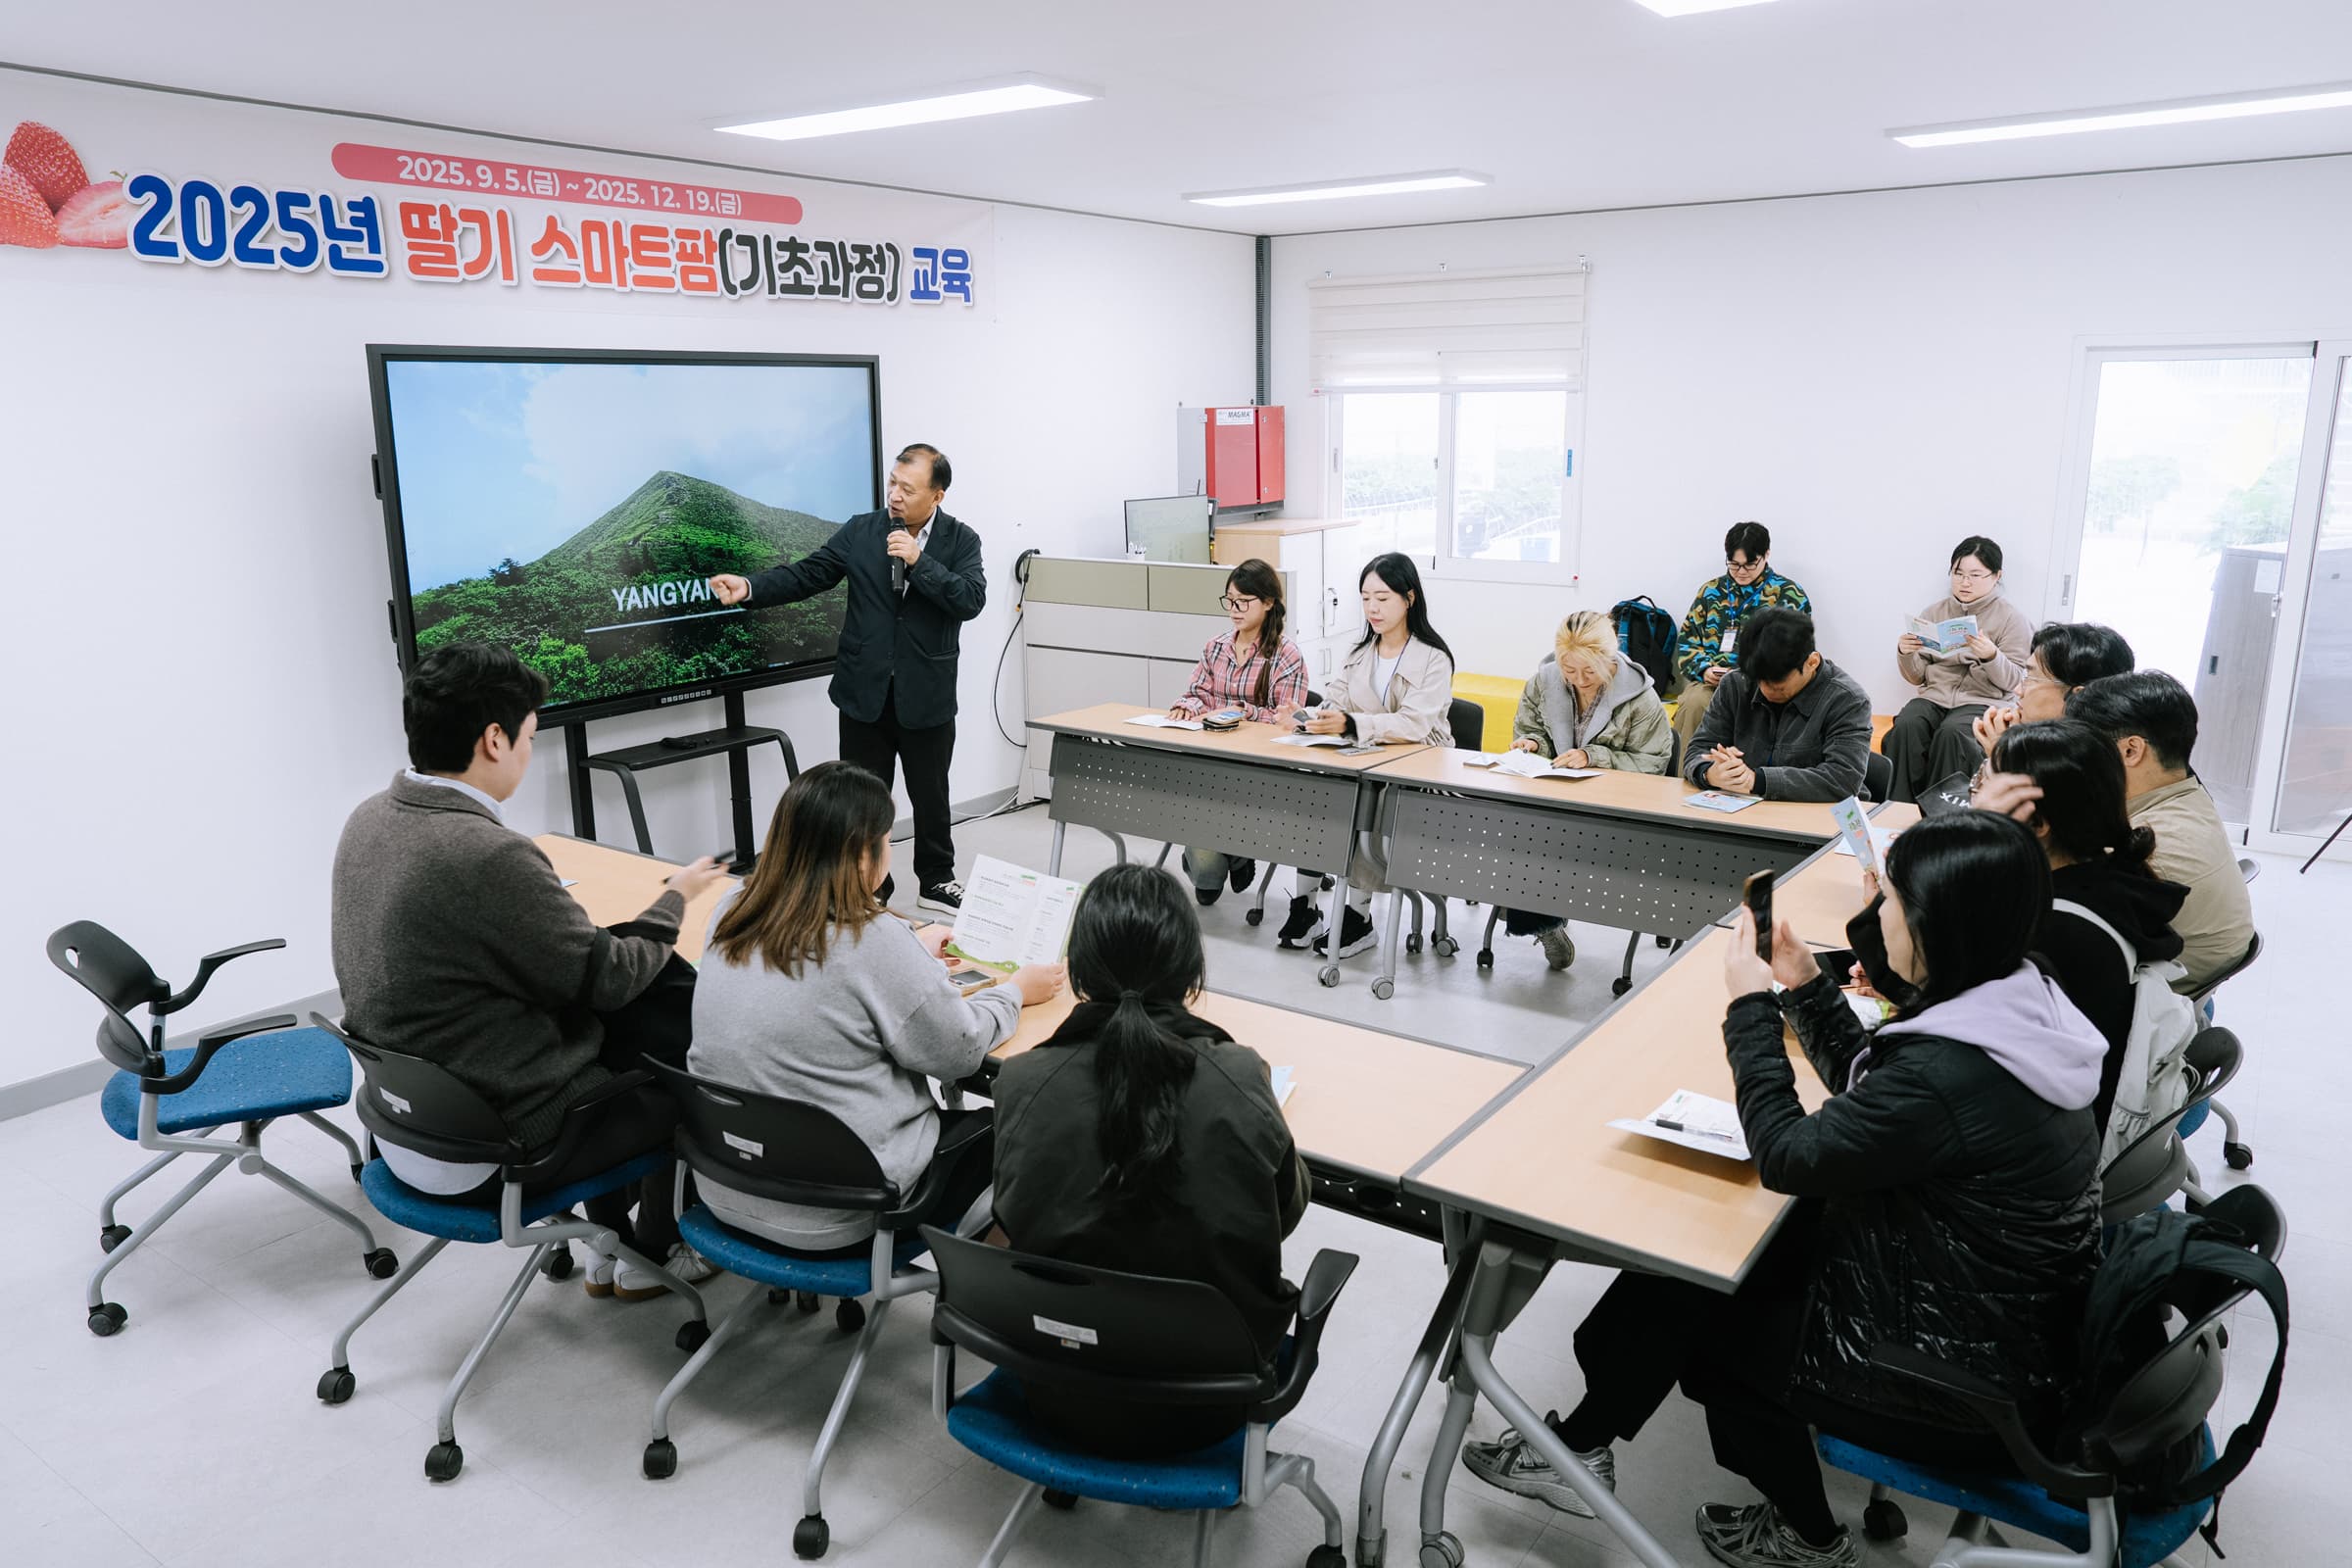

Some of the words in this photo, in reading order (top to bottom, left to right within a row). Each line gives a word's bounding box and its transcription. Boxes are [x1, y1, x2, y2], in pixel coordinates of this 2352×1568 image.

[396, 154, 472, 187] 2025.
[475, 165, 500, 189] 9.
[504, 168, 561, 197] 5.(금)
[583, 176, 646, 205] 2025.
[650, 184, 681, 209] 12.
[685, 189, 743, 217] 19.(금)
[126, 172, 386, 275] 2025년
[399, 200, 515, 282] 딸기
[909, 246, 972, 304] 교육
